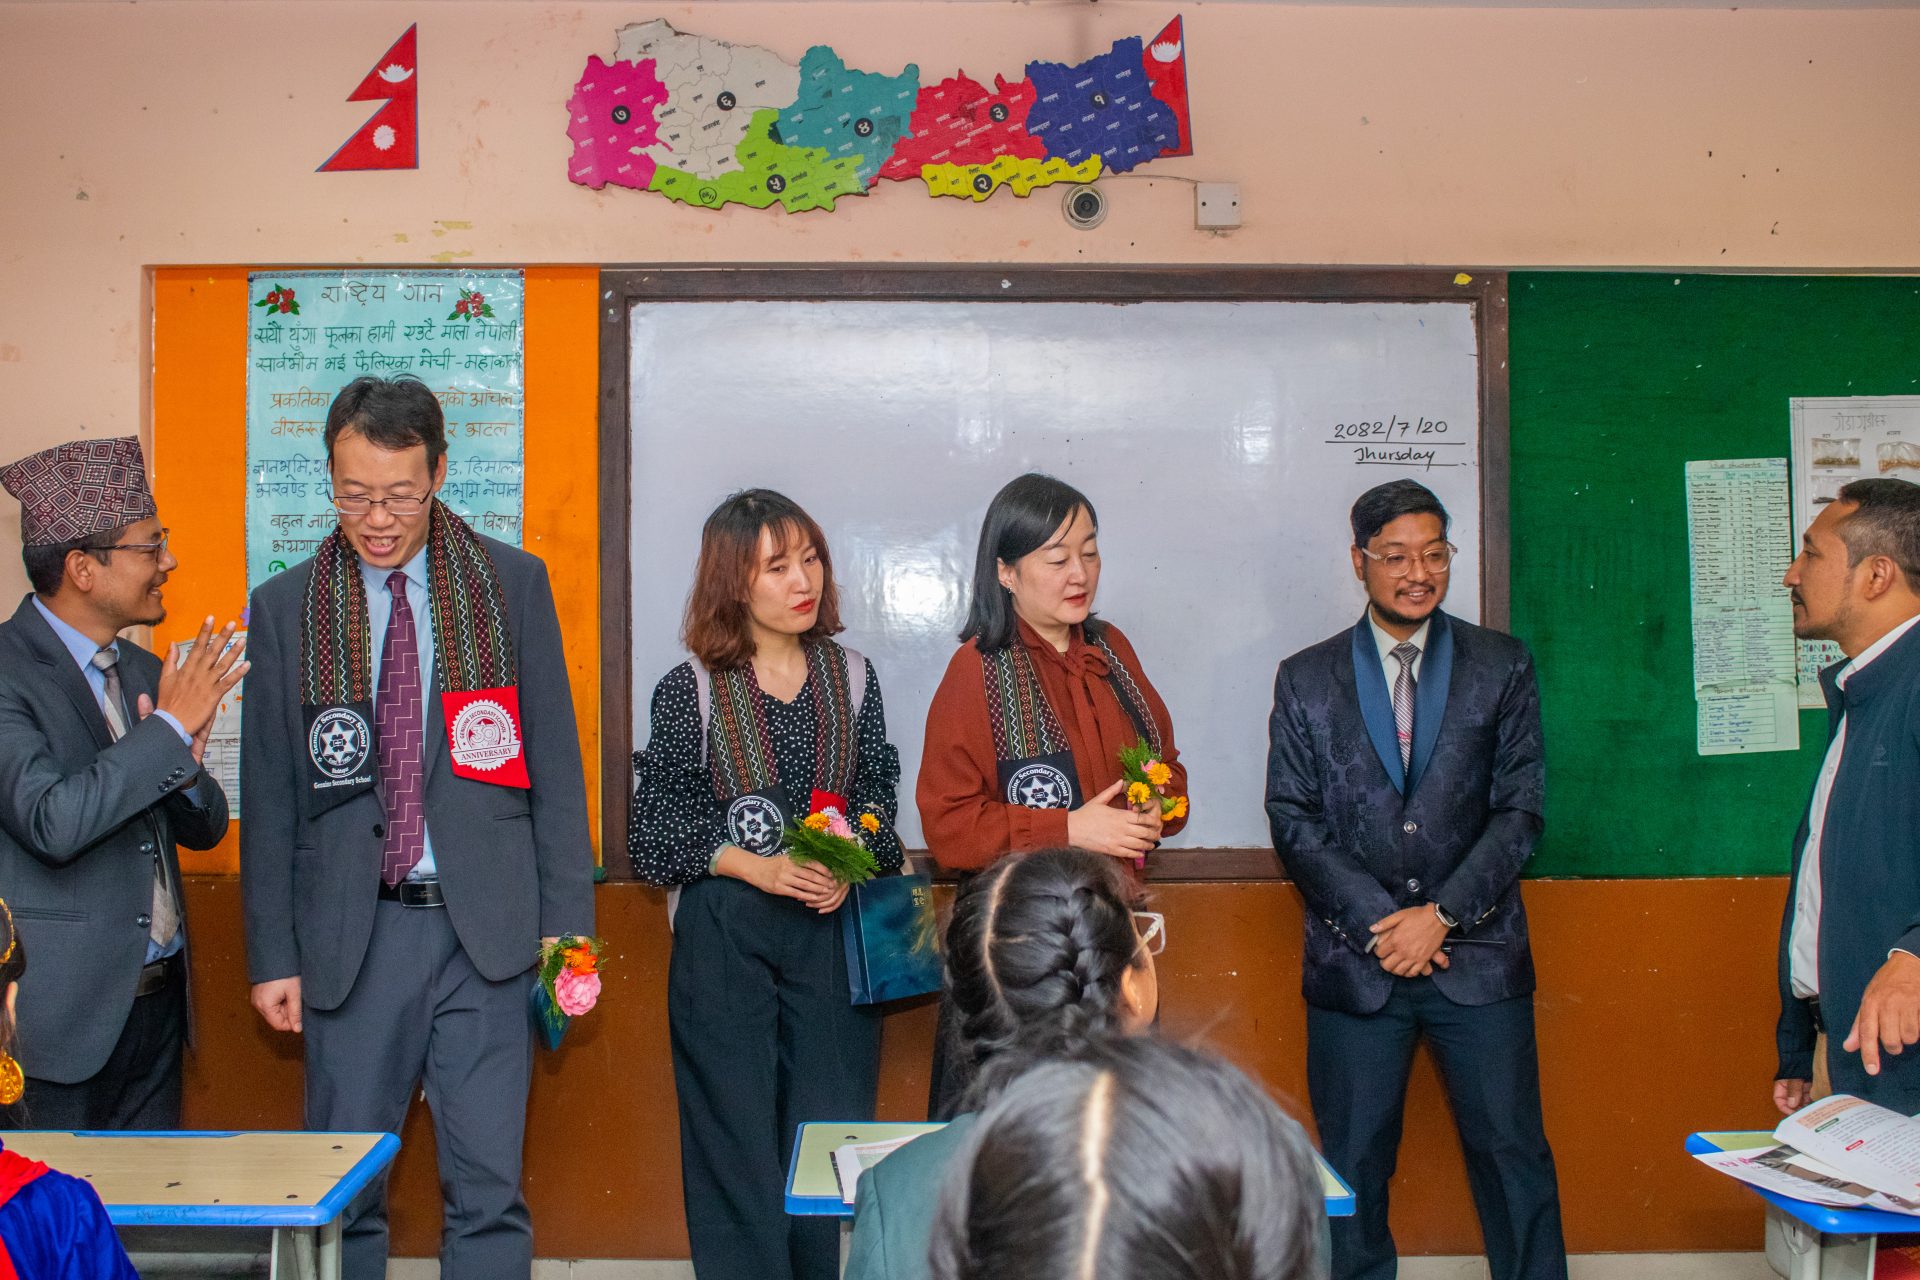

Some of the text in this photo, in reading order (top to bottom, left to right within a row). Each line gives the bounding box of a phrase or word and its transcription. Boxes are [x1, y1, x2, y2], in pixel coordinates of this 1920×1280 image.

[403, 283, 445, 303] गान
[324, 326, 364, 350] फूलका
[368, 319, 396, 343] हामी
[403, 318, 436, 341] एउटै
[440, 325, 470, 341] माला
[475, 318, 519, 341] नेपाली
[256, 351, 319, 373] सार्वभौम
[324, 353, 346, 372] भई
[352, 350, 415, 372] फैलिएका
[447, 422, 459, 438] र
[465, 422, 515, 438] अटल
[1334, 414, 1448, 443] 2082/7/20
[464, 455, 518, 476] हिमाल
[1353, 446, 1436, 472] Thursday
[256, 482, 309, 499] अखण्ड
[438, 479, 481, 505] ातृभूमि
[483, 478, 521, 498] नेपाल
[271, 514, 305, 536] बहुल
[482, 510, 519, 531] विशाल
[1802, 643, 1839, 652] MONDAY
[321, 712, 357, 724] Secondary
[355, 722, 366, 747] School
[461, 747, 513, 760] ANNIVERSARY
[331, 777, 355, 786] Secondary
[355, 775, 372, 784] School
[1018, 768, 1055, 779] Secondary
[1054, 774, 1069, 797] School
[732, 799, 761, 814] Secondary
[762, 803, 780, 823] School
